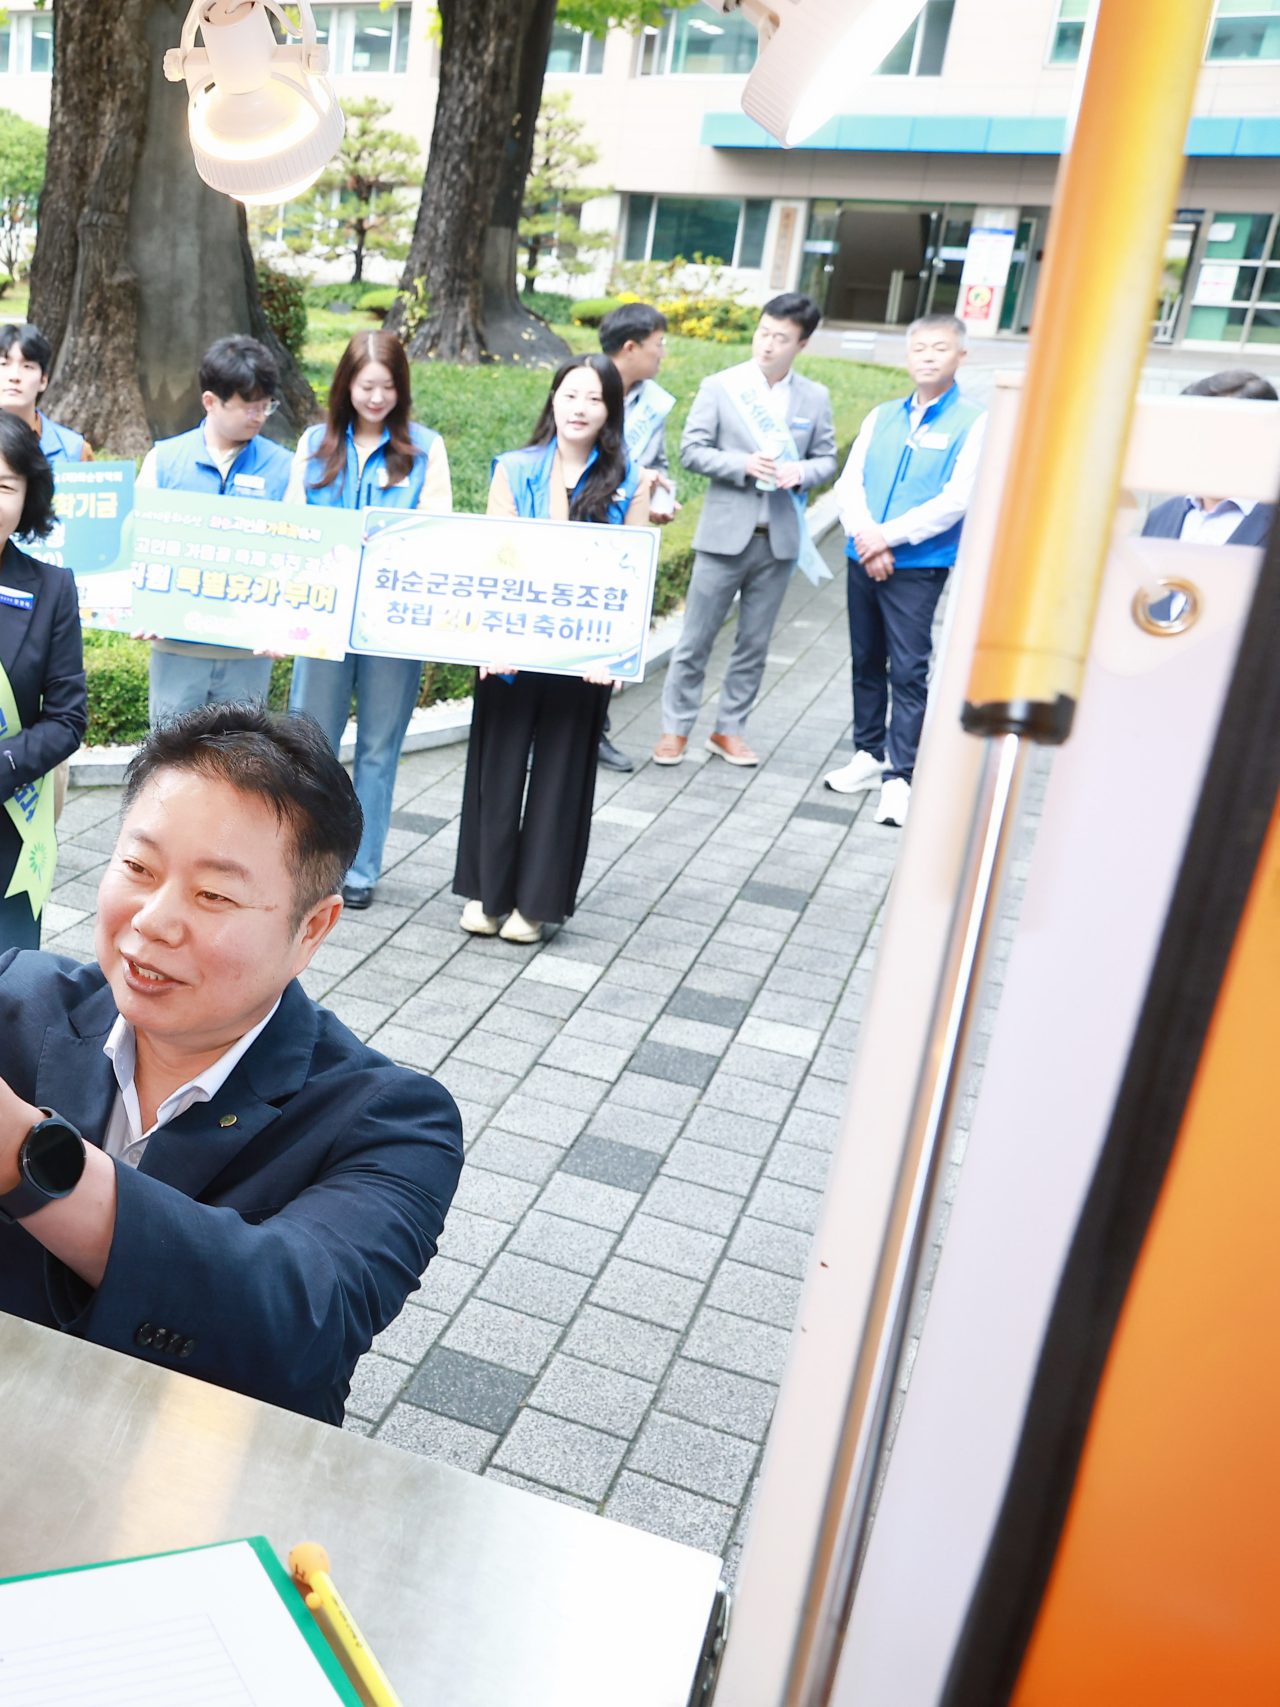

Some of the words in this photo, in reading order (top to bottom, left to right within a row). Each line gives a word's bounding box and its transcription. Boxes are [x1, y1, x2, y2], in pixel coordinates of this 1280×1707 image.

[176, 566, 281, 607] 특별휴가
[284, 582, 337, 614] 부여
[375, 567, 629, 612] 화순군공무원노동조합
[386, 600, 433, 627] 창립
[533, 613, 613, 644] 축하!!!
